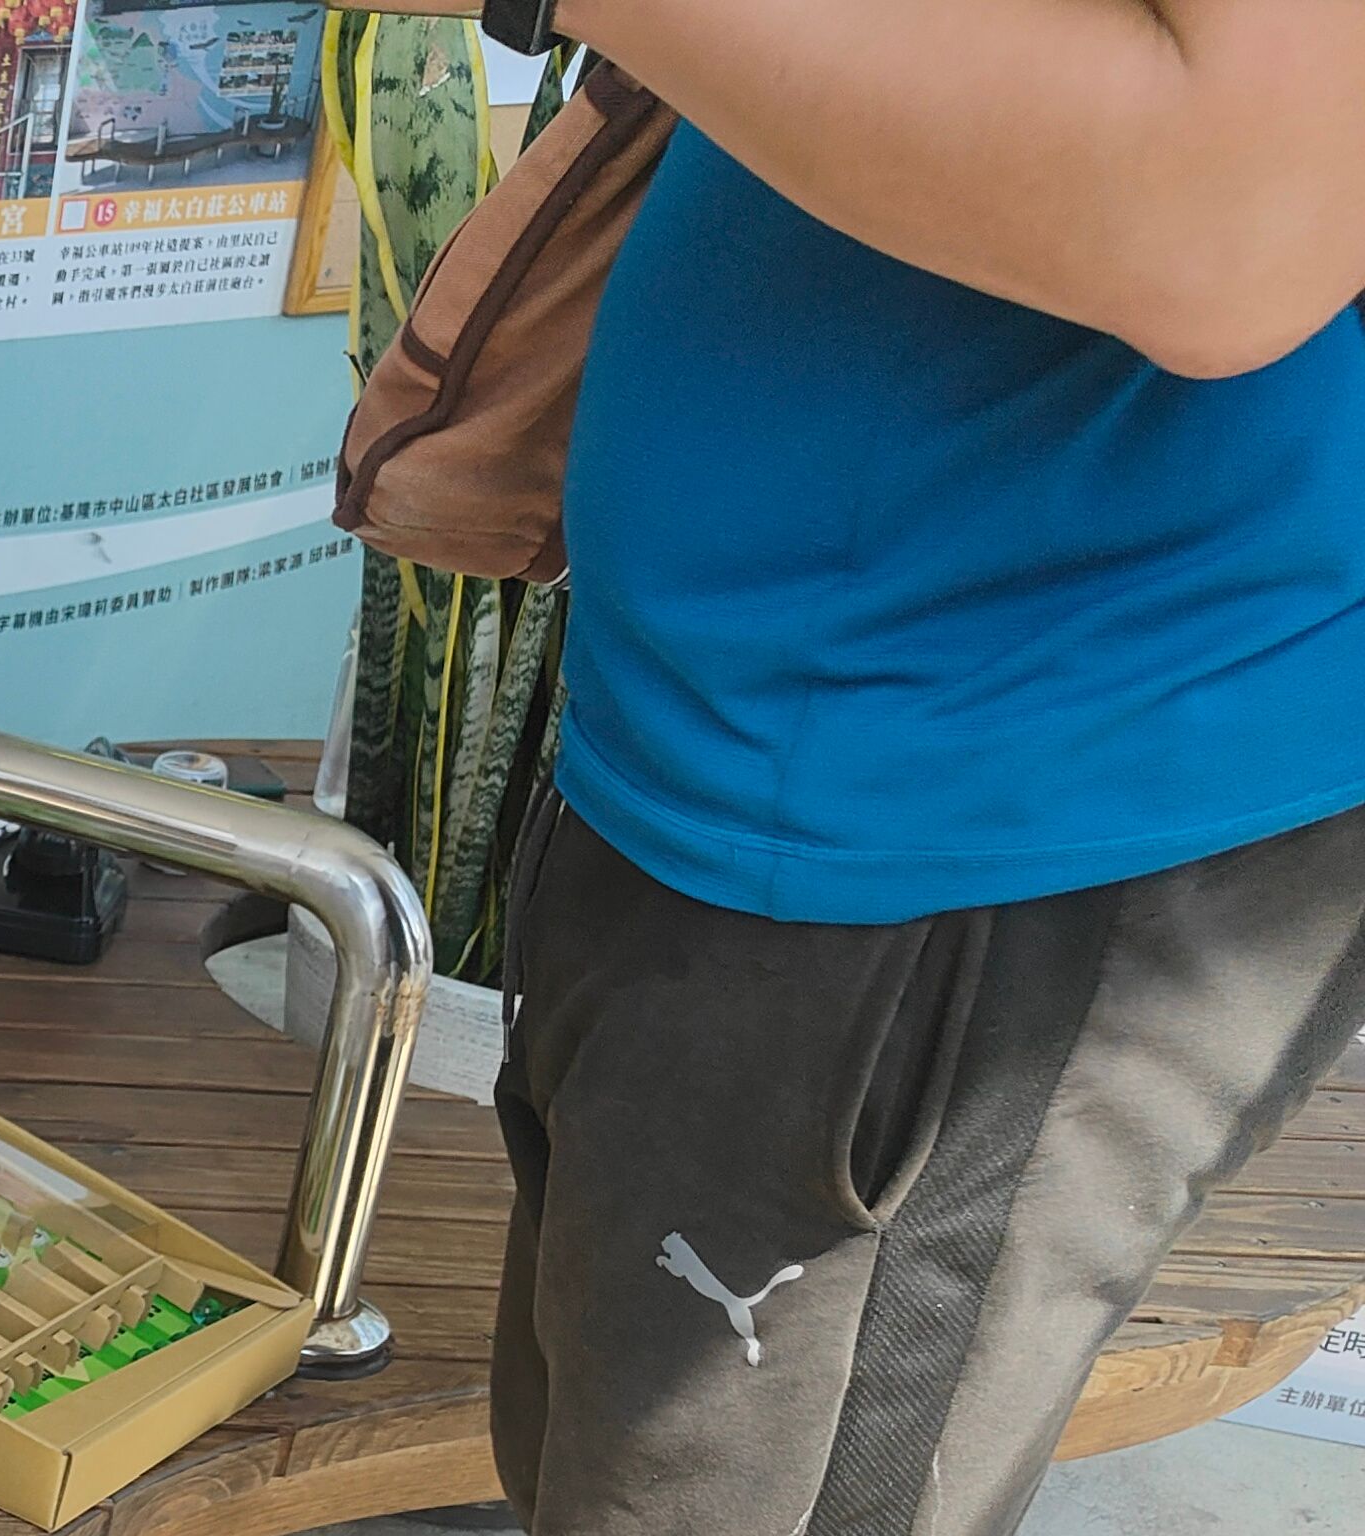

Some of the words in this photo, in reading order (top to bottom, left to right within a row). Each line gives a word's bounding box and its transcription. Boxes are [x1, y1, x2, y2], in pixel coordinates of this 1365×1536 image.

[97, 202, 115, 221] 15
[124, 190, 287, 224] 幸福太白莊公車站
